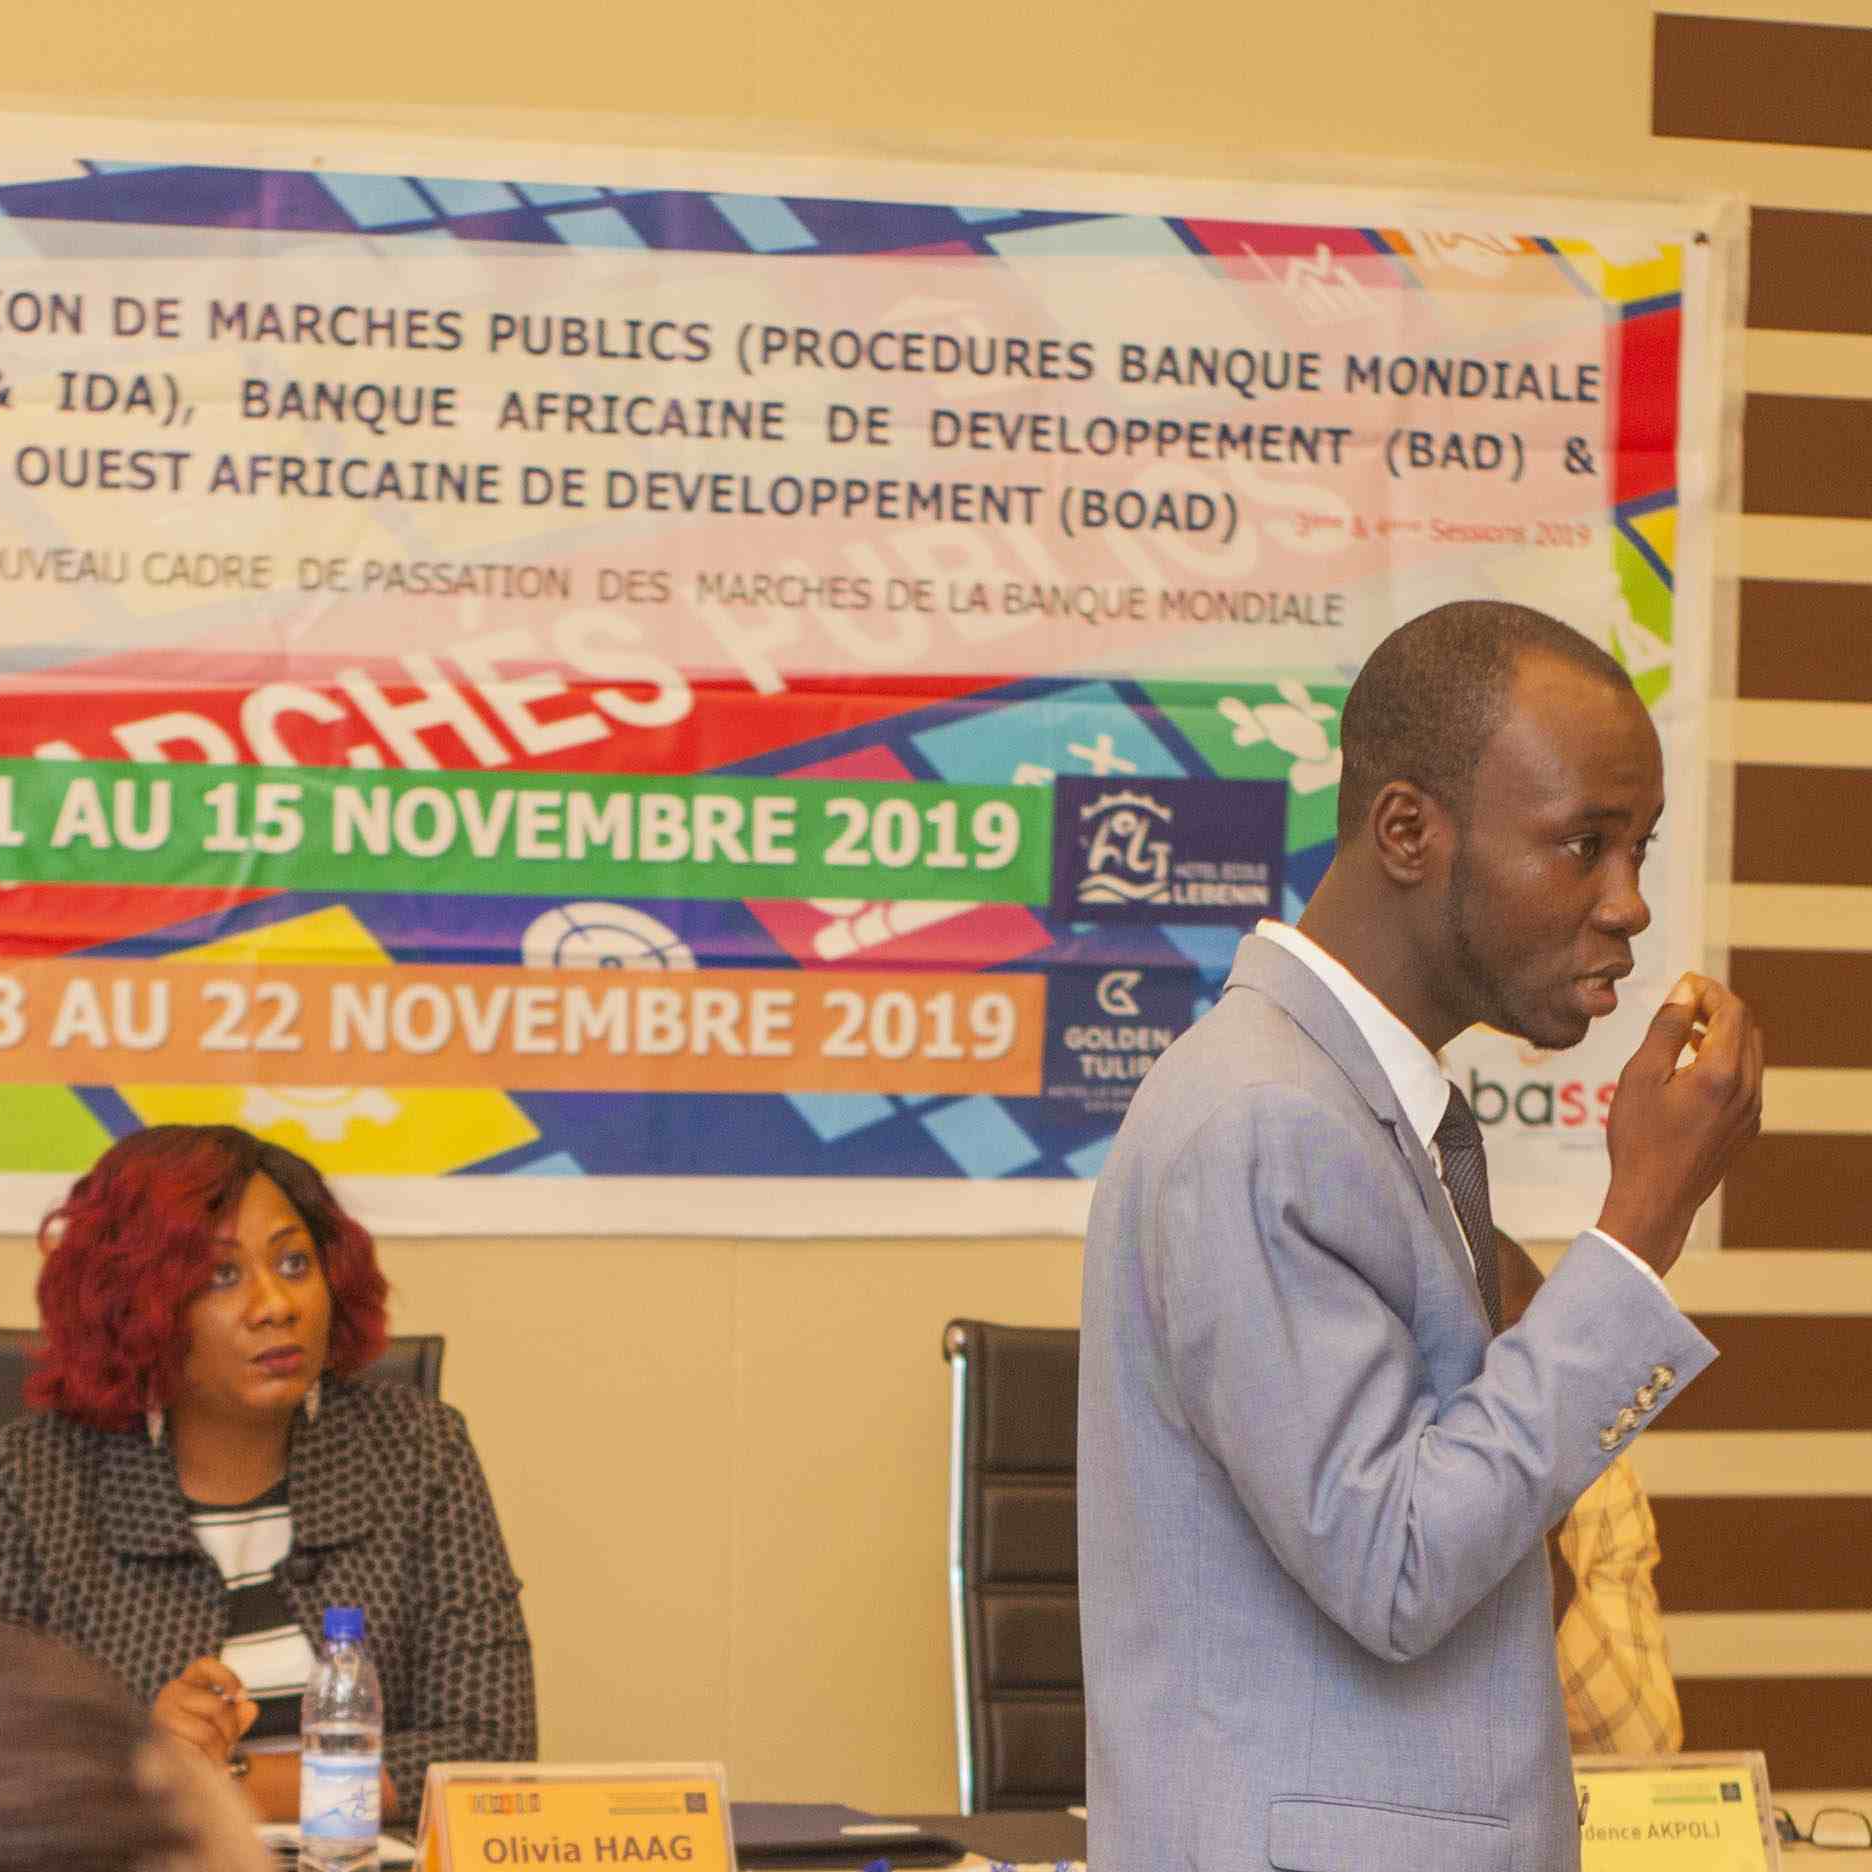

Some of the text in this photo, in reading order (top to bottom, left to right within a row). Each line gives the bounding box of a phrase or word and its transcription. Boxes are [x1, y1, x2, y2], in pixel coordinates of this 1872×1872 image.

[110, 295, 182, 339] DE
[208, 299, 464, 353] MARCHES
[488, 314, 712, 363] PUBLICS
[738, 323, 1095, 382] (PROCEDURES
[1118, 342, 1323, 402] BANQUE
[1346, 353, 1603, 404] MONDIALE
[59, 372, 198, 428] IDA),
[241, 378, 457, 435] BANQUE
[497, 391, 785, 442] AFRICAINE
[827, 406, 891, 445] DE
[930, 411, 1351, 466] DEVELOPPEMENT
[1384, 428, 1526, 479] (BAD)
[1563, 438, 1598, 477] &
[15, 445, 191, 494] OUEST
[208, 456, 500, 504] AFRICAINE
[520, 465, 585, 509] DE
[606, 469, 1045, 527] DEVELOPPEMENT
[1059, 484, 1239, 542] (BOAD)
[142, 551, 271, 591] CADRE
[297, 557, 348, 591] DE
[361, 561, 570, 600] PASSATION
[596, 568, 671, 604] DES
[696, 571, 874, 610] MARCHES
[884, 578, 936, 613] DE
[949, 578, 989, 617] LA
[1000, 584, 1146, 625] BANQUE
[1159, 588, 1344, 627] MONDIALE
[52, 777, 172, 853] AU
[202, 782, 304, 855] 15
[334, 784, 796, 866] NOVEMBRE
[822, 796, 1021, 872] 2019
[52, 979, 170, 1050] AU
[202, 982, 303, 1052] 22
[334, 984, 794, 1055] NOVEMBRE
[822, 991, 1019, 1061] 2019
[1064, 1025, 1173, 1052] GOLDEN
[480, 1830, 694, 1865] Olivia HAAG
